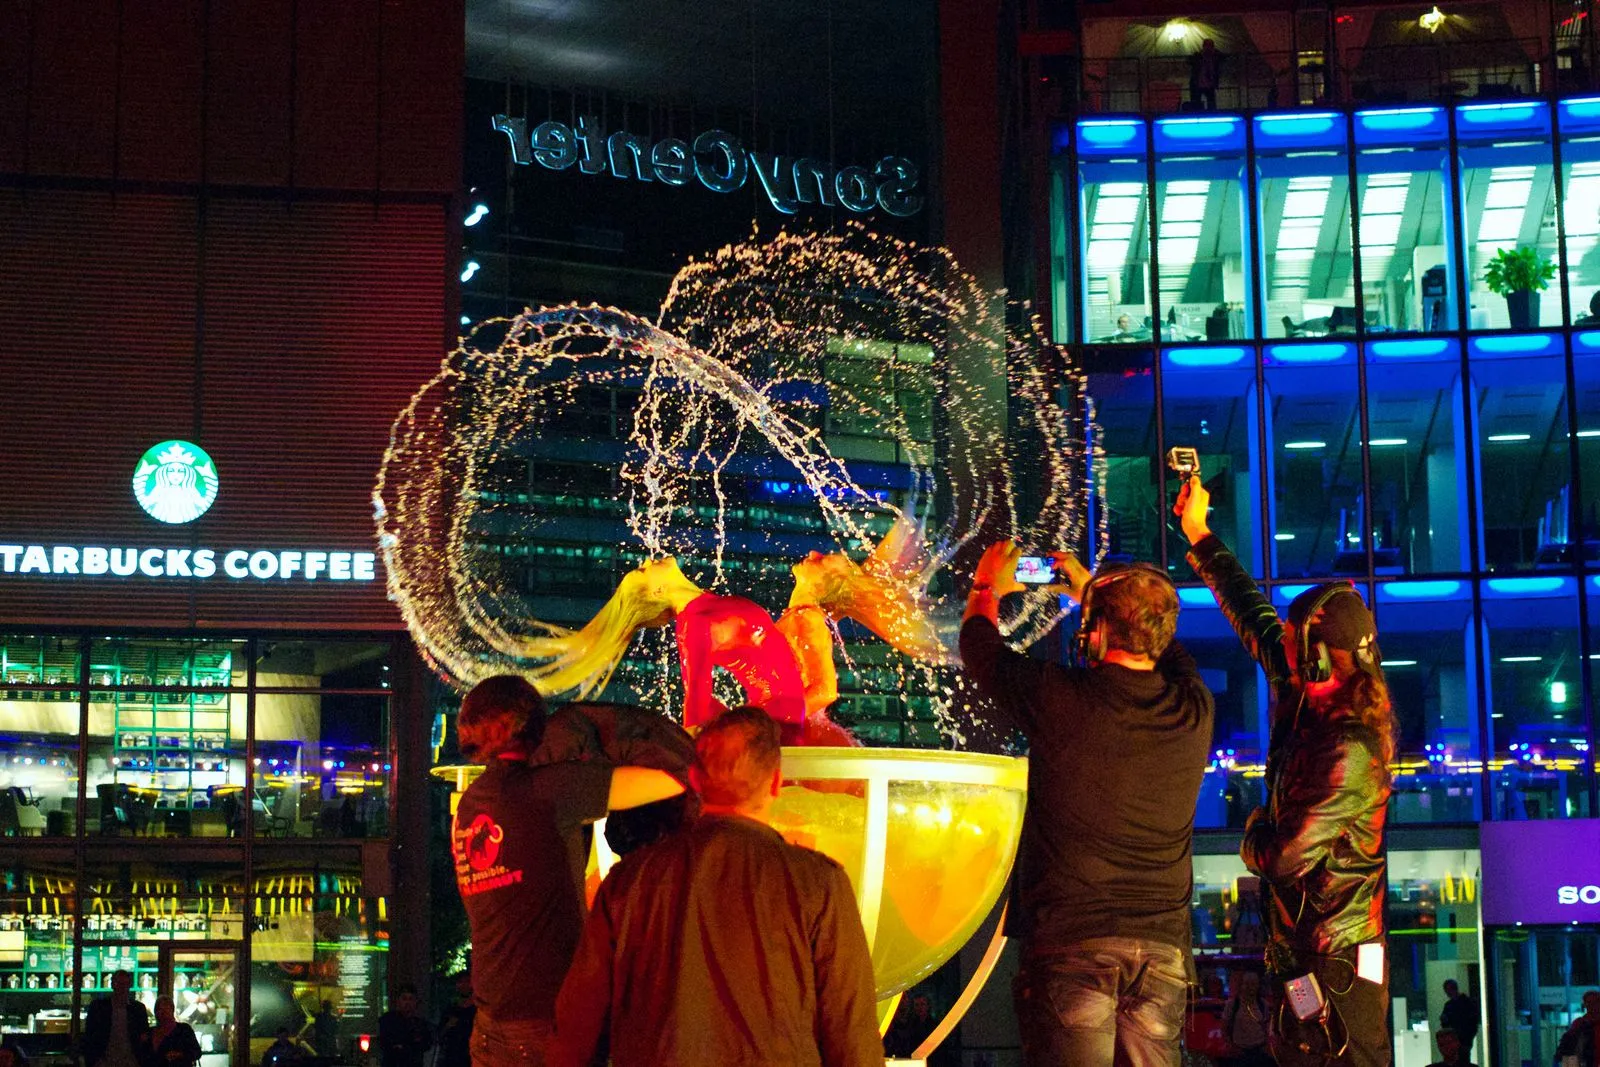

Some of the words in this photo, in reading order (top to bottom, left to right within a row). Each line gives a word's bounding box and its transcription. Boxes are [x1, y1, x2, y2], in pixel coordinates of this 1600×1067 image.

[0, 545, 217, 578] TARBUCKS
[223, 550, 376, 580] COFFEE
[1557, 885, 1600, 905] SO
